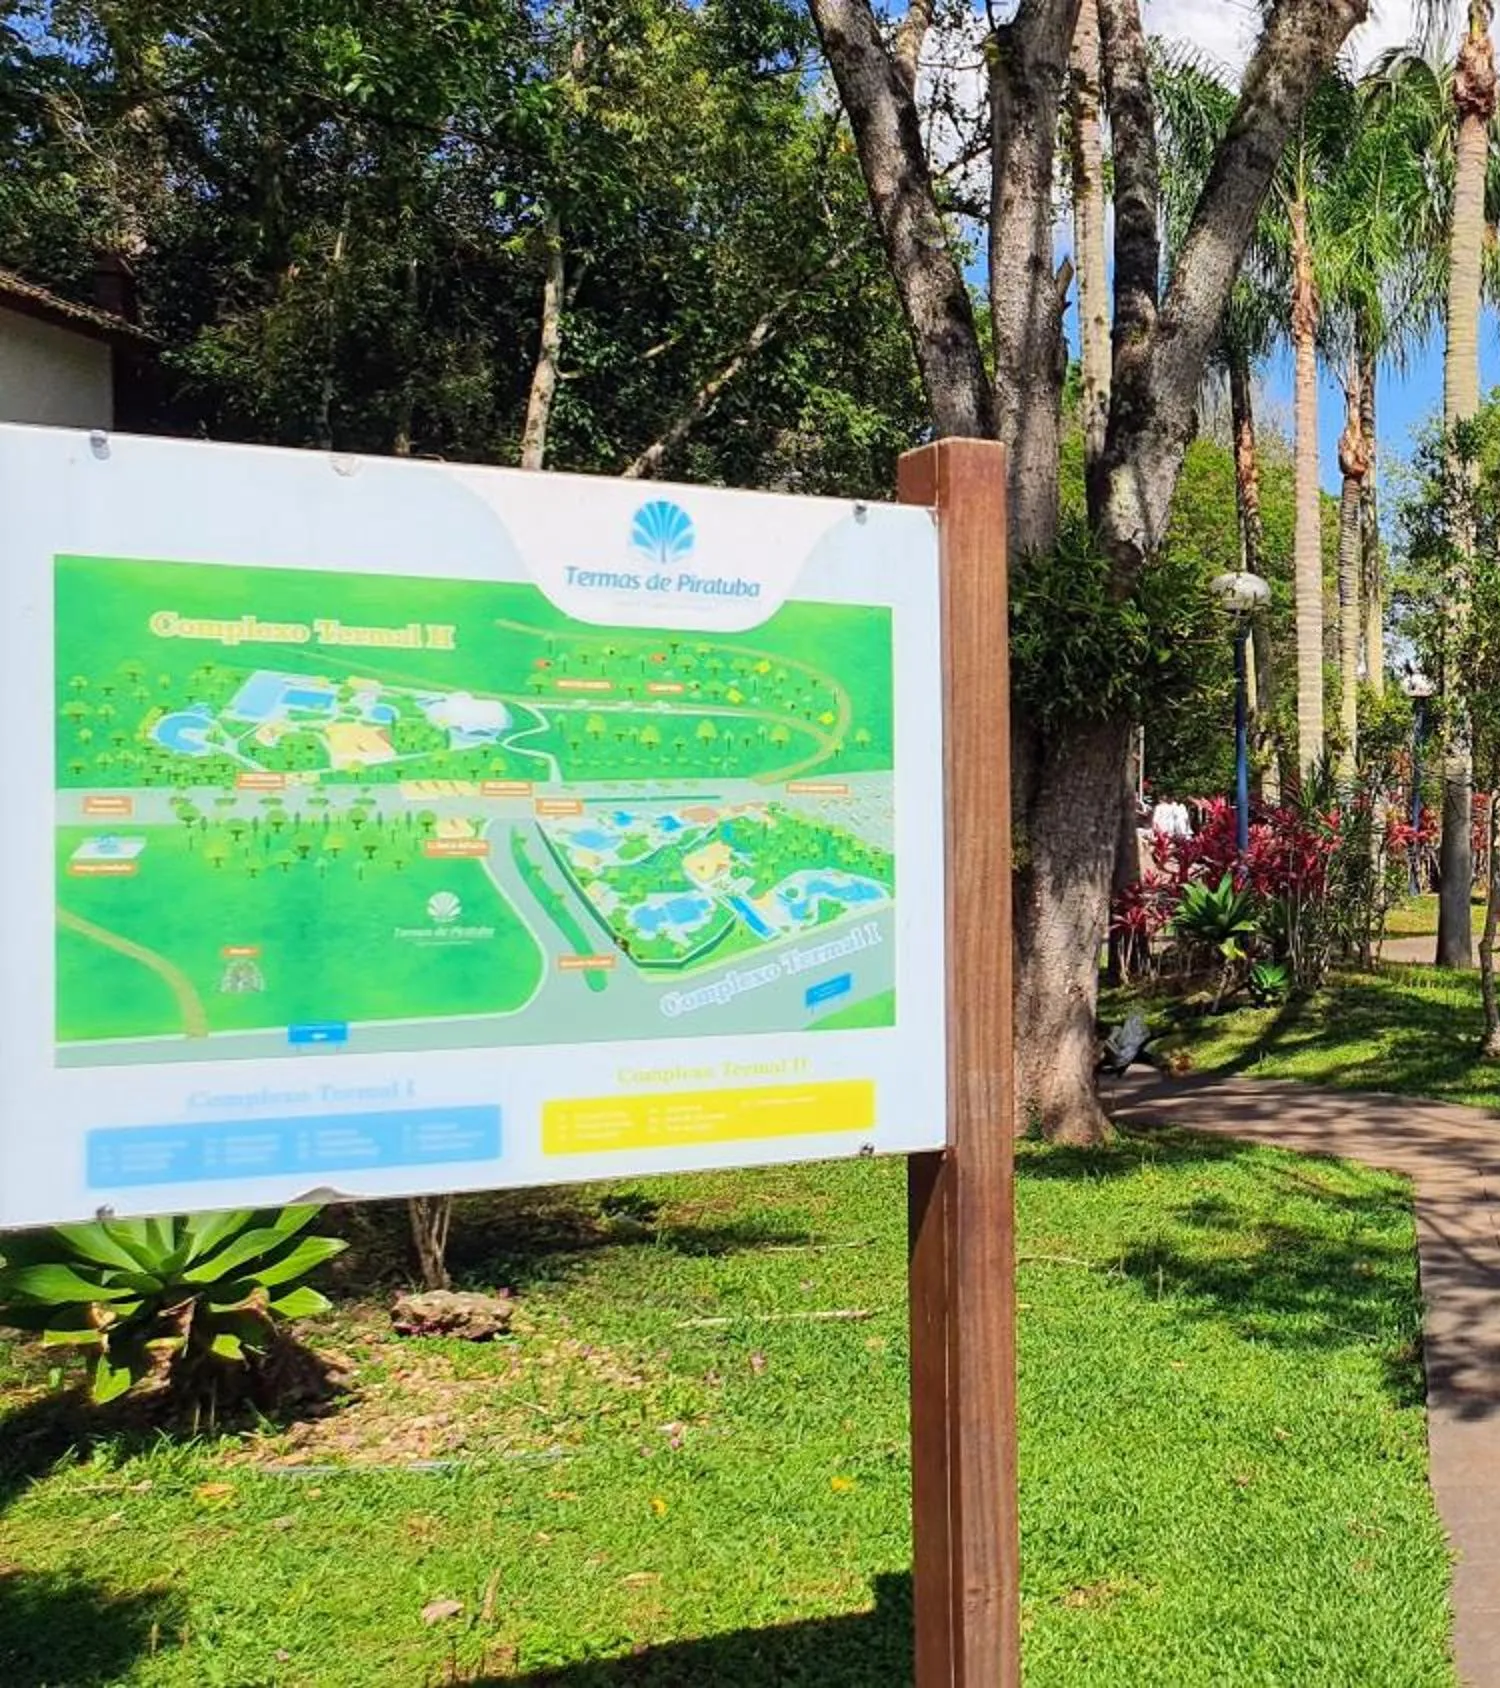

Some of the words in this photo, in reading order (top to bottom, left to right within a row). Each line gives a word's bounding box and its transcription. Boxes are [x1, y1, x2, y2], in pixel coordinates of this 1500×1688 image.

[564, 566, 641, 592] Termas
[646, 573, 672, 593] de
[678, 574, 762, 599] Piratuba
